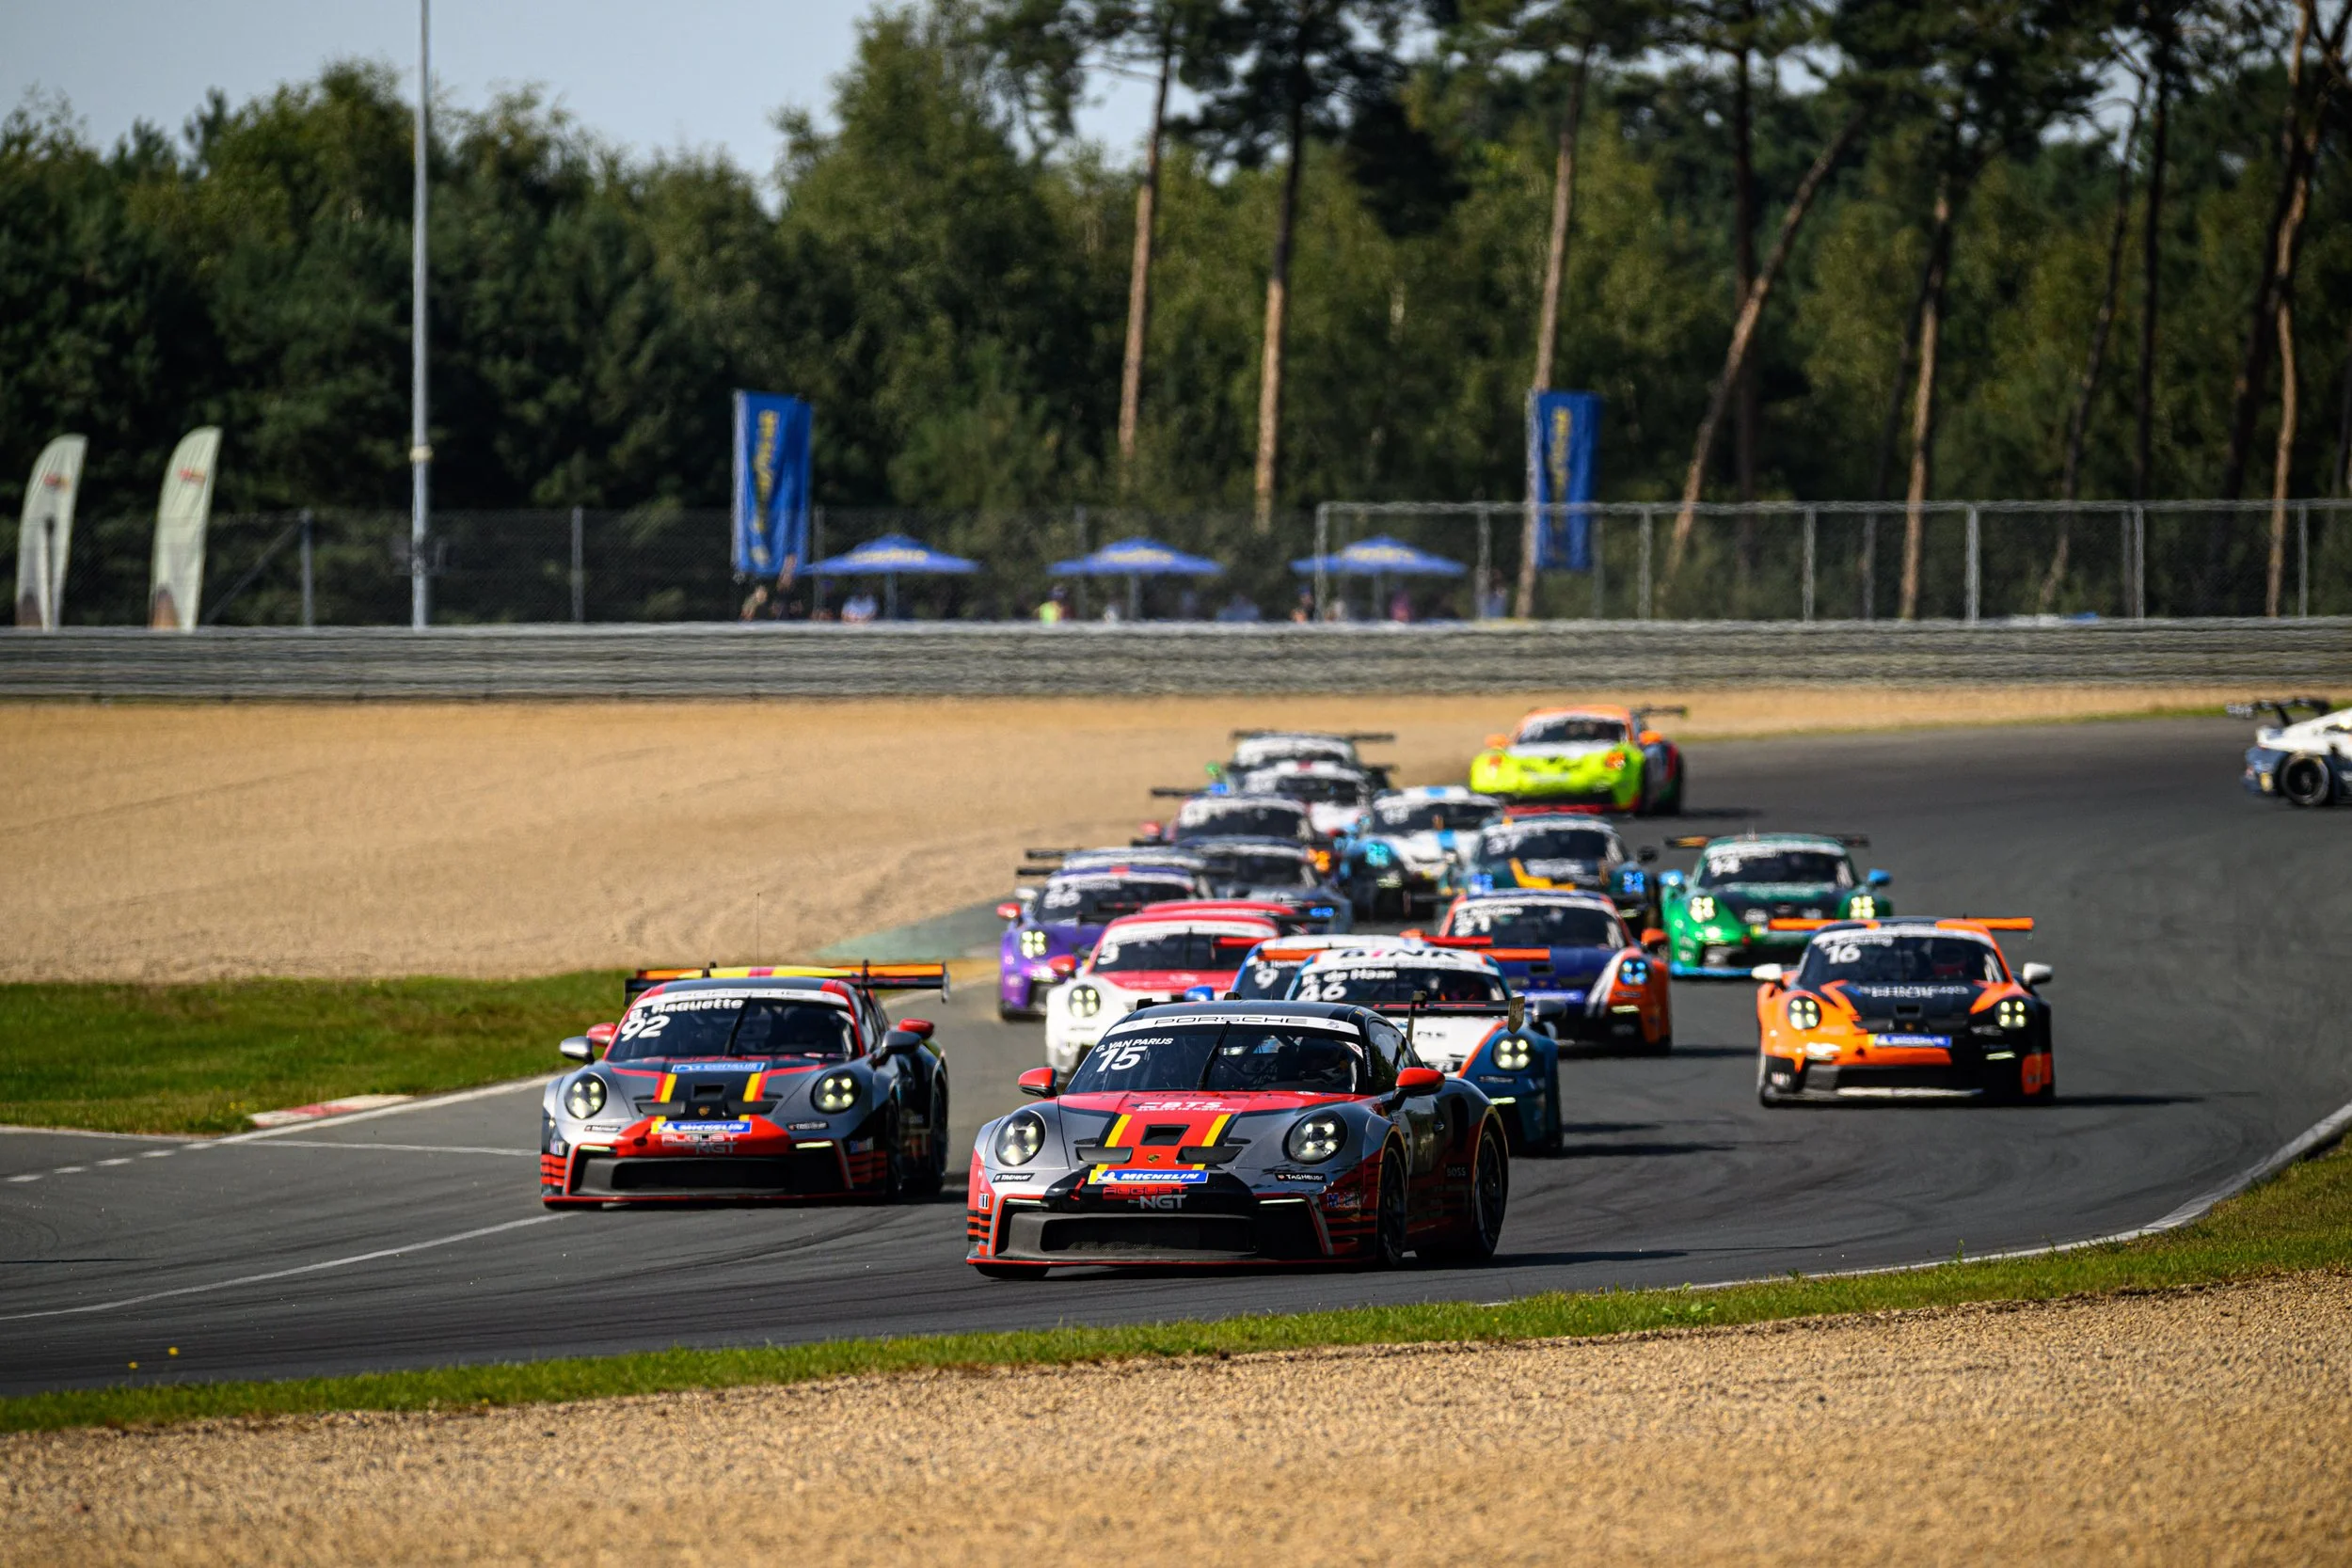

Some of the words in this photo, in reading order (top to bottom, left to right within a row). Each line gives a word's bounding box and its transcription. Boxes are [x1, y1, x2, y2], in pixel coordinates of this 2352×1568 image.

[1827, 943, 1862, 965] 16
[1254, 968, 1279, 990] 9
[1323, 969, 1348, 983] de
[1350, 968, 1398, 981] Haan
[620, 1015, 671, 1042] 92
[1153, 1016, 1308, 1026] PORSCHE
[1095, 1044, 1106, 1053] G.
[1109, 1038, 1133, 1051] VAN
[1095, 1045, 1148, 1073] 15
[660, 1134, 739, 1143] AUGUST
[695, 1143, 738, 1155] NGT
[1103, 1186, 1188, 1196] AUGUST
[1139, 1194, 1188, 1209] NGT
